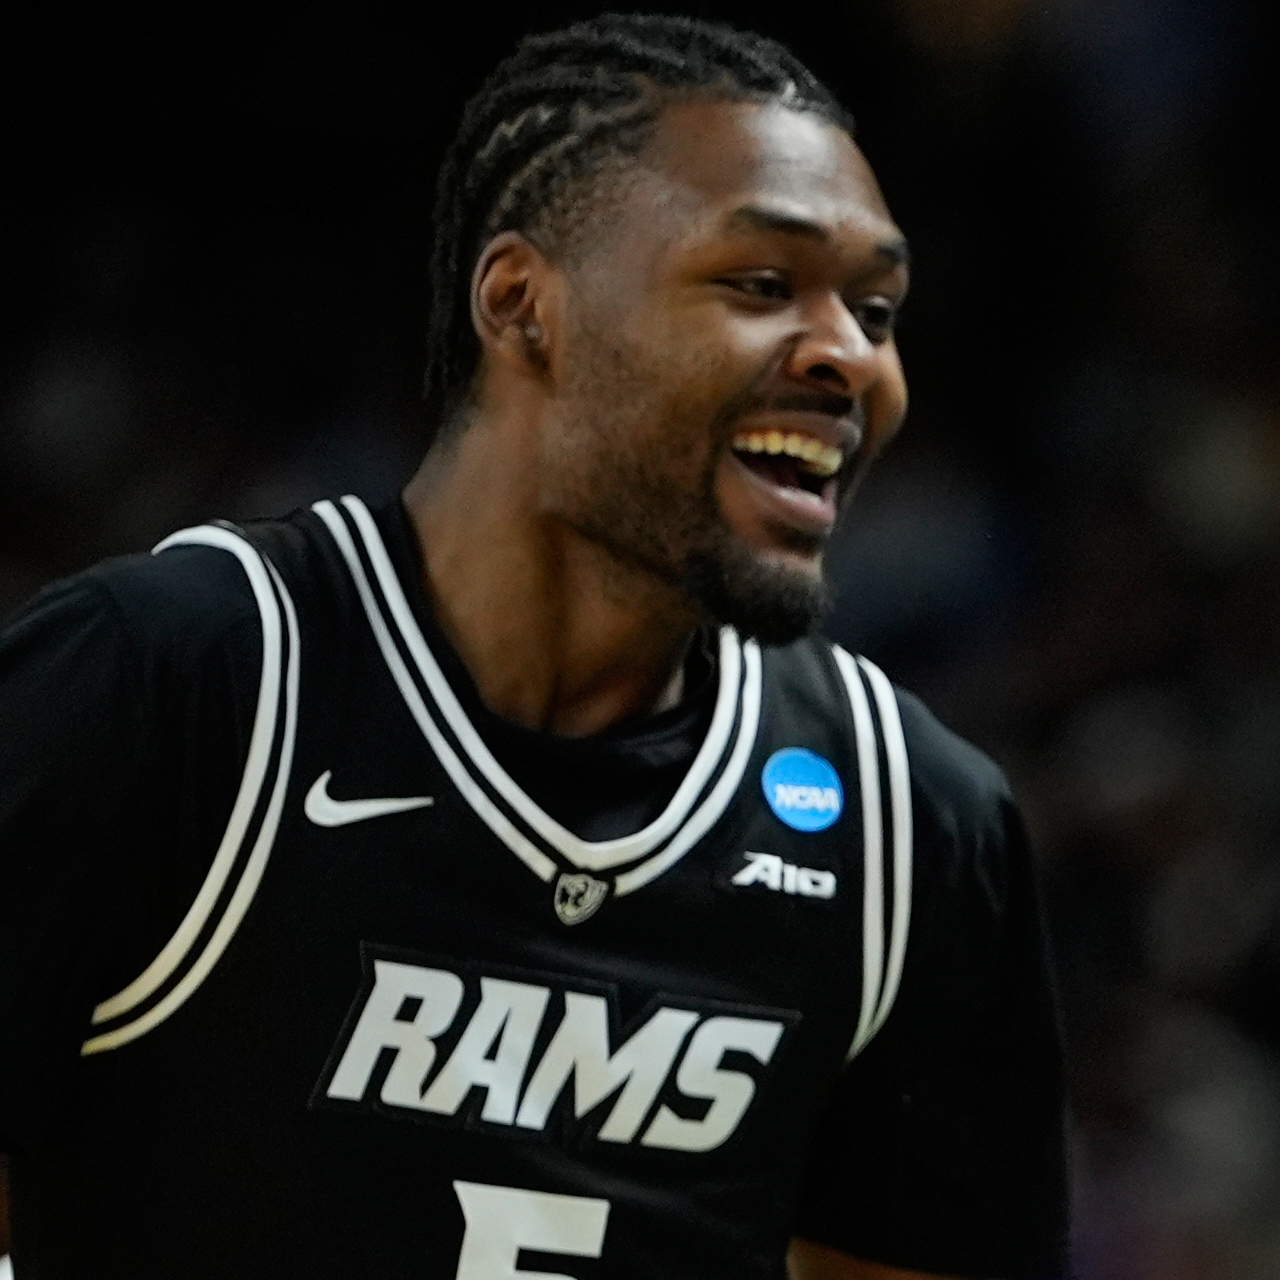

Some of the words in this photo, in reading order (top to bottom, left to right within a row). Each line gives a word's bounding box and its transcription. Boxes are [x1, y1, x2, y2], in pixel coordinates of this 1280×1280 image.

[774, 783, 840, 812] NCAA
[731, 851, 836, 899] A10
[326, 959, 785, 1153] RAMS
